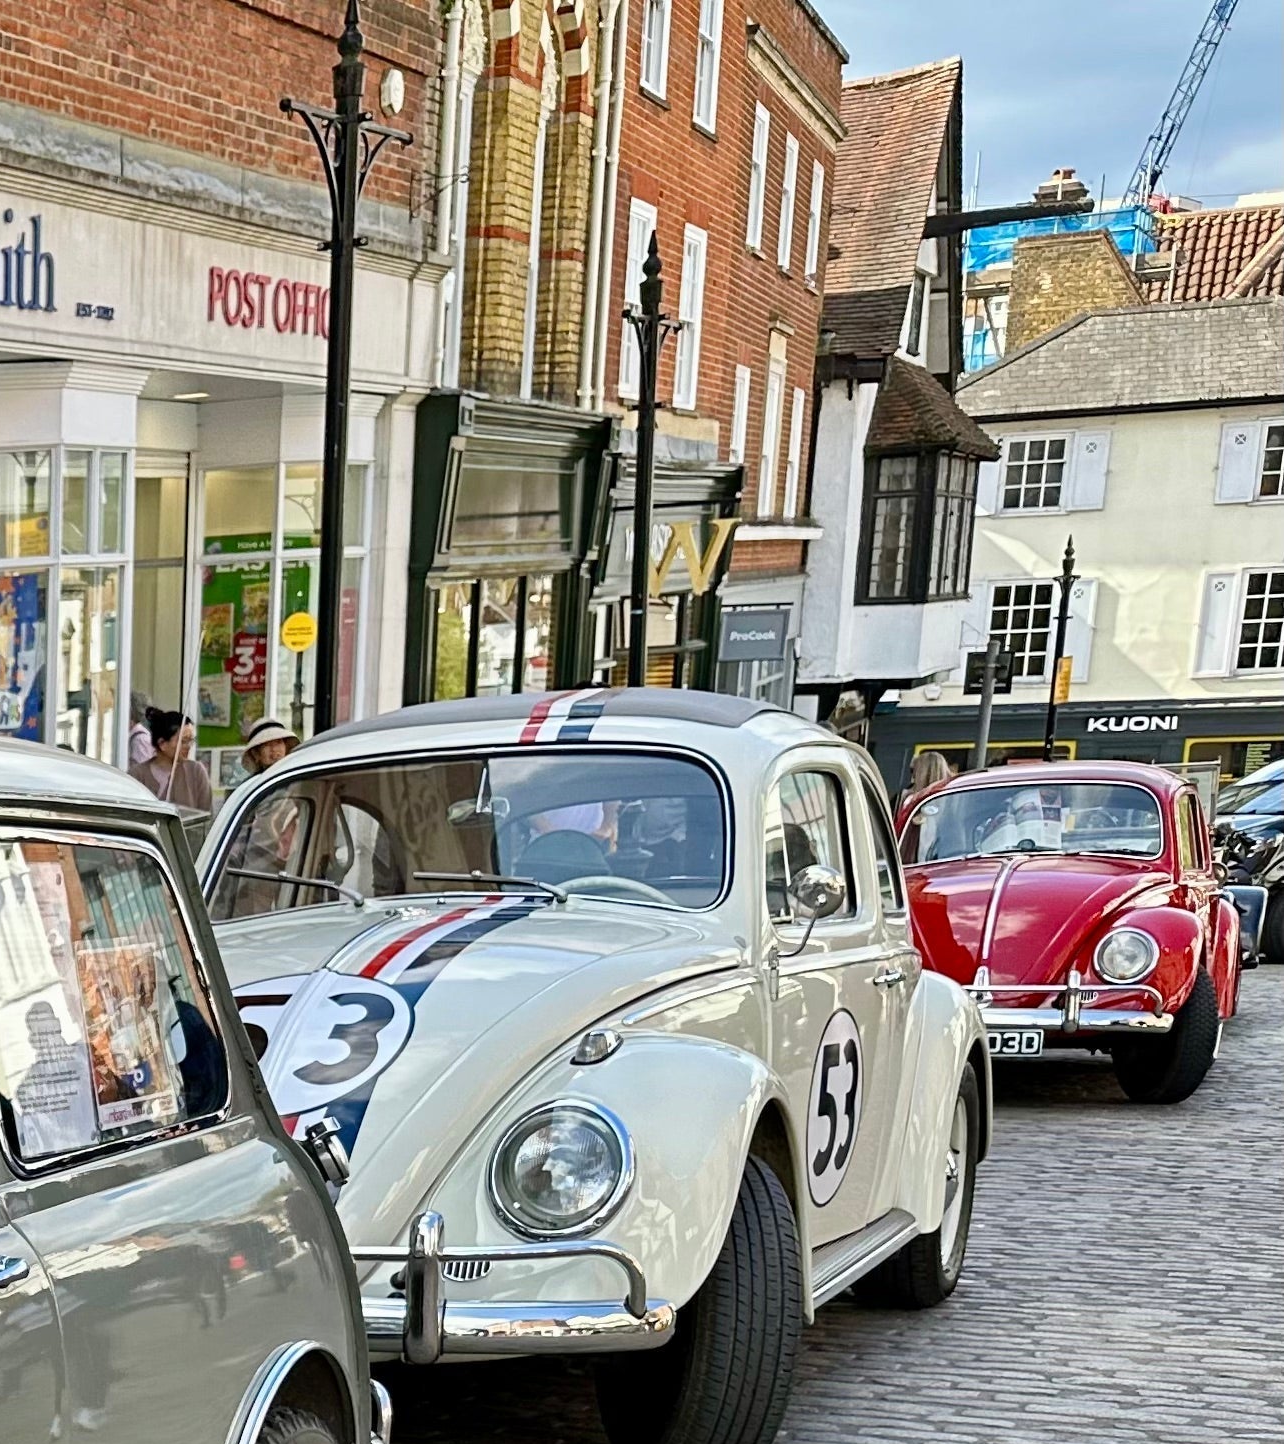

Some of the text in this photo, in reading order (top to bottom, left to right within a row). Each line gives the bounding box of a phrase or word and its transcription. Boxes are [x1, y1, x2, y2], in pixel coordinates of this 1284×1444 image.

[207, 266, 331, 340] POST OFFIC
[729, 629, 777, 643] ProCook
[233, 646, 255, 676] 3
[1086, 715, 1179, 733] KUONI
[987, 1032, 1040, 1054] 03D
[813, 1038, 859, 1177] 53
